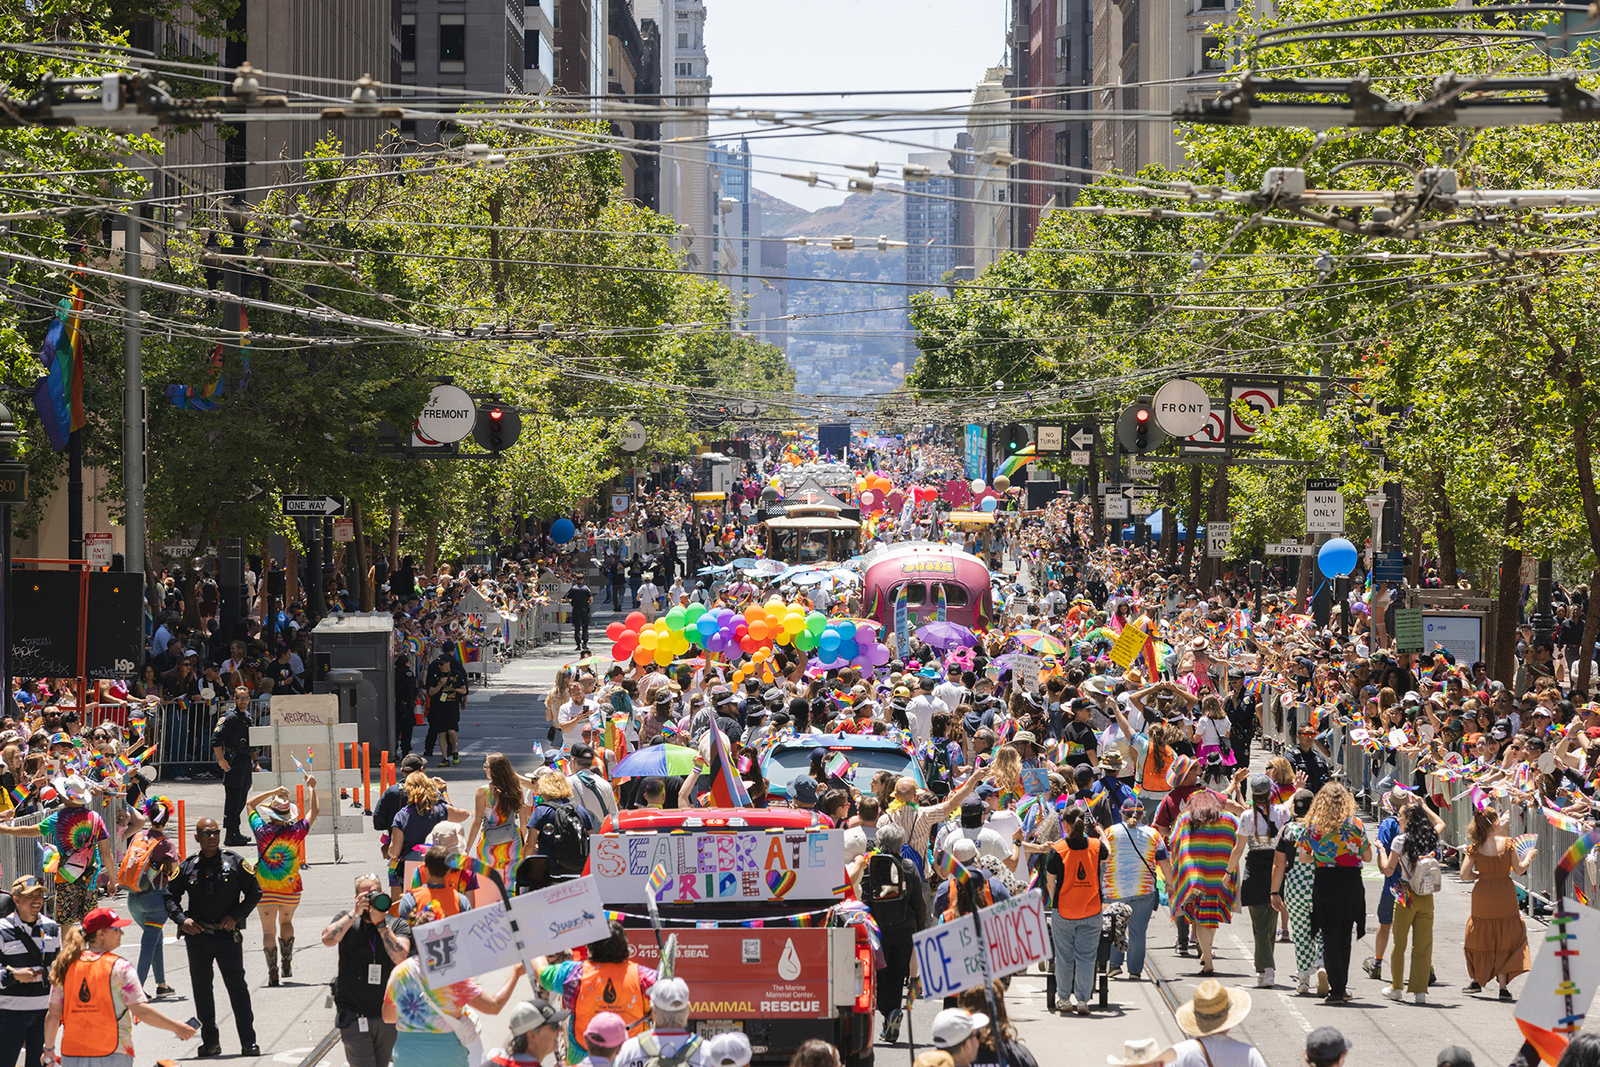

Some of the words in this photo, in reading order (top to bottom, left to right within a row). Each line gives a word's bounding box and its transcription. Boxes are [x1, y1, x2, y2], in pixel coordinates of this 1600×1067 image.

[424, 410, 469, 419] FREMONT
[1162, 404, 1204, 413] FRONT
[289, 502, 306, 510] ONE
[308, 502, 326, 510] WAY
[1314, 496, 1337, 504] MUNI
[1313, 509, 1336, 517] ONLY
[597, 834, 829, 878] SEALEBRATE
[543, 881, 590, 903] SHARKS!
[656, 871, 761, 901] PRIDE
[483, 926, 514, 955] YOU
[914, 931, 962, 999] ICE
[983, 898, 1047, 974] HOCKEY
[959, 927, 972, 949] IS
[425, 935, 456, 967] SF
[689, 1002, 756, 1013] MAMMAL
[760, 1001, 820, 1012] RESCUE
